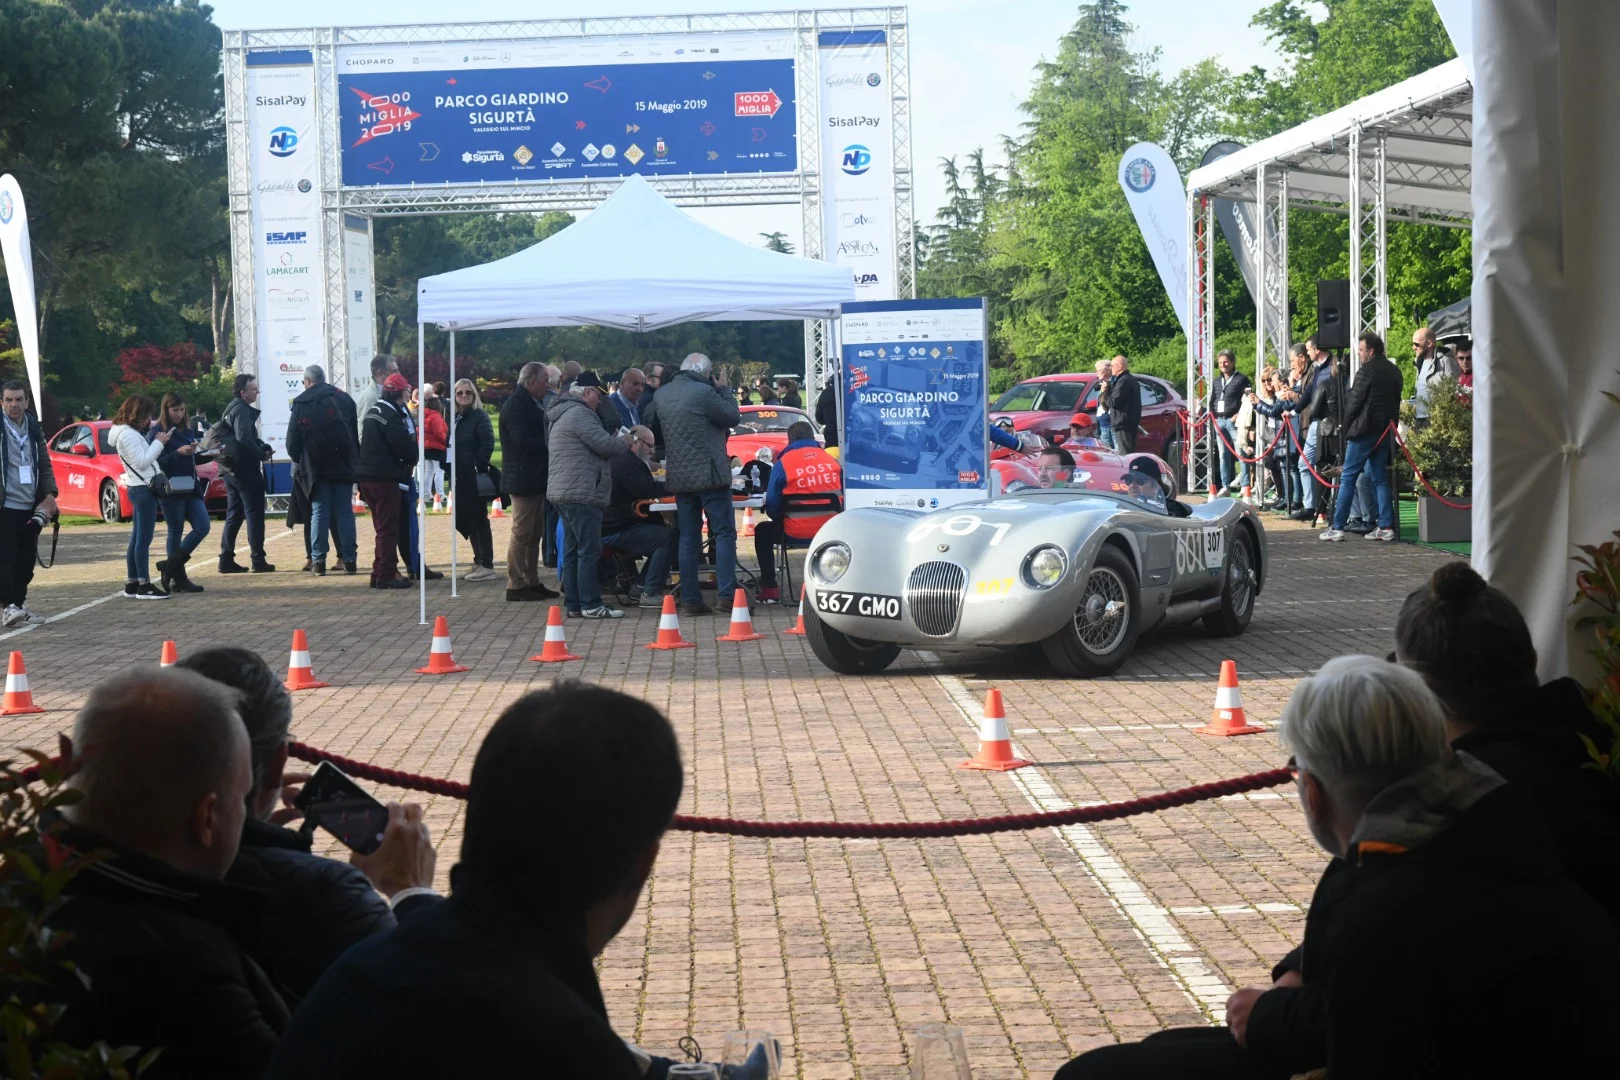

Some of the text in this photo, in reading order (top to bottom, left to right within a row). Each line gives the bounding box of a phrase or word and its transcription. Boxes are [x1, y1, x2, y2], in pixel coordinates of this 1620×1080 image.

[346, 58, 394, 67] CHOPARD
[256, 95, 307, 107] SisalPay
[360, 92, 411, 110] 1000
[434, 91, 569, 108] PARCO GIARDINO
[739, 94, 769, 103] 1000
[635, 99, 708, 114] 15 Maggio 2019
[737, 104, 772, 114] MIGLIA
[359, 105, 413, 124] MIGLIA
[468, 106, 536, 125] SIGURTÀ
[828, 116, 880, 128] SisalPay
[360, 121, 412, 139] 2019
[473, 152, 505, 164] Sigurtà
[266, 266, 310, 276] LAMACART
[860, 391, 959, 404] PARCO GIARDINO
[880, 403, 931, 419] SIGURTÀ
[796, 463, 833, 478] POST
[797, 472, 838, 489] CHIEF
[1207, 531, 1221, 553] 307
[817, 591, 900, 618] 367 GMO
